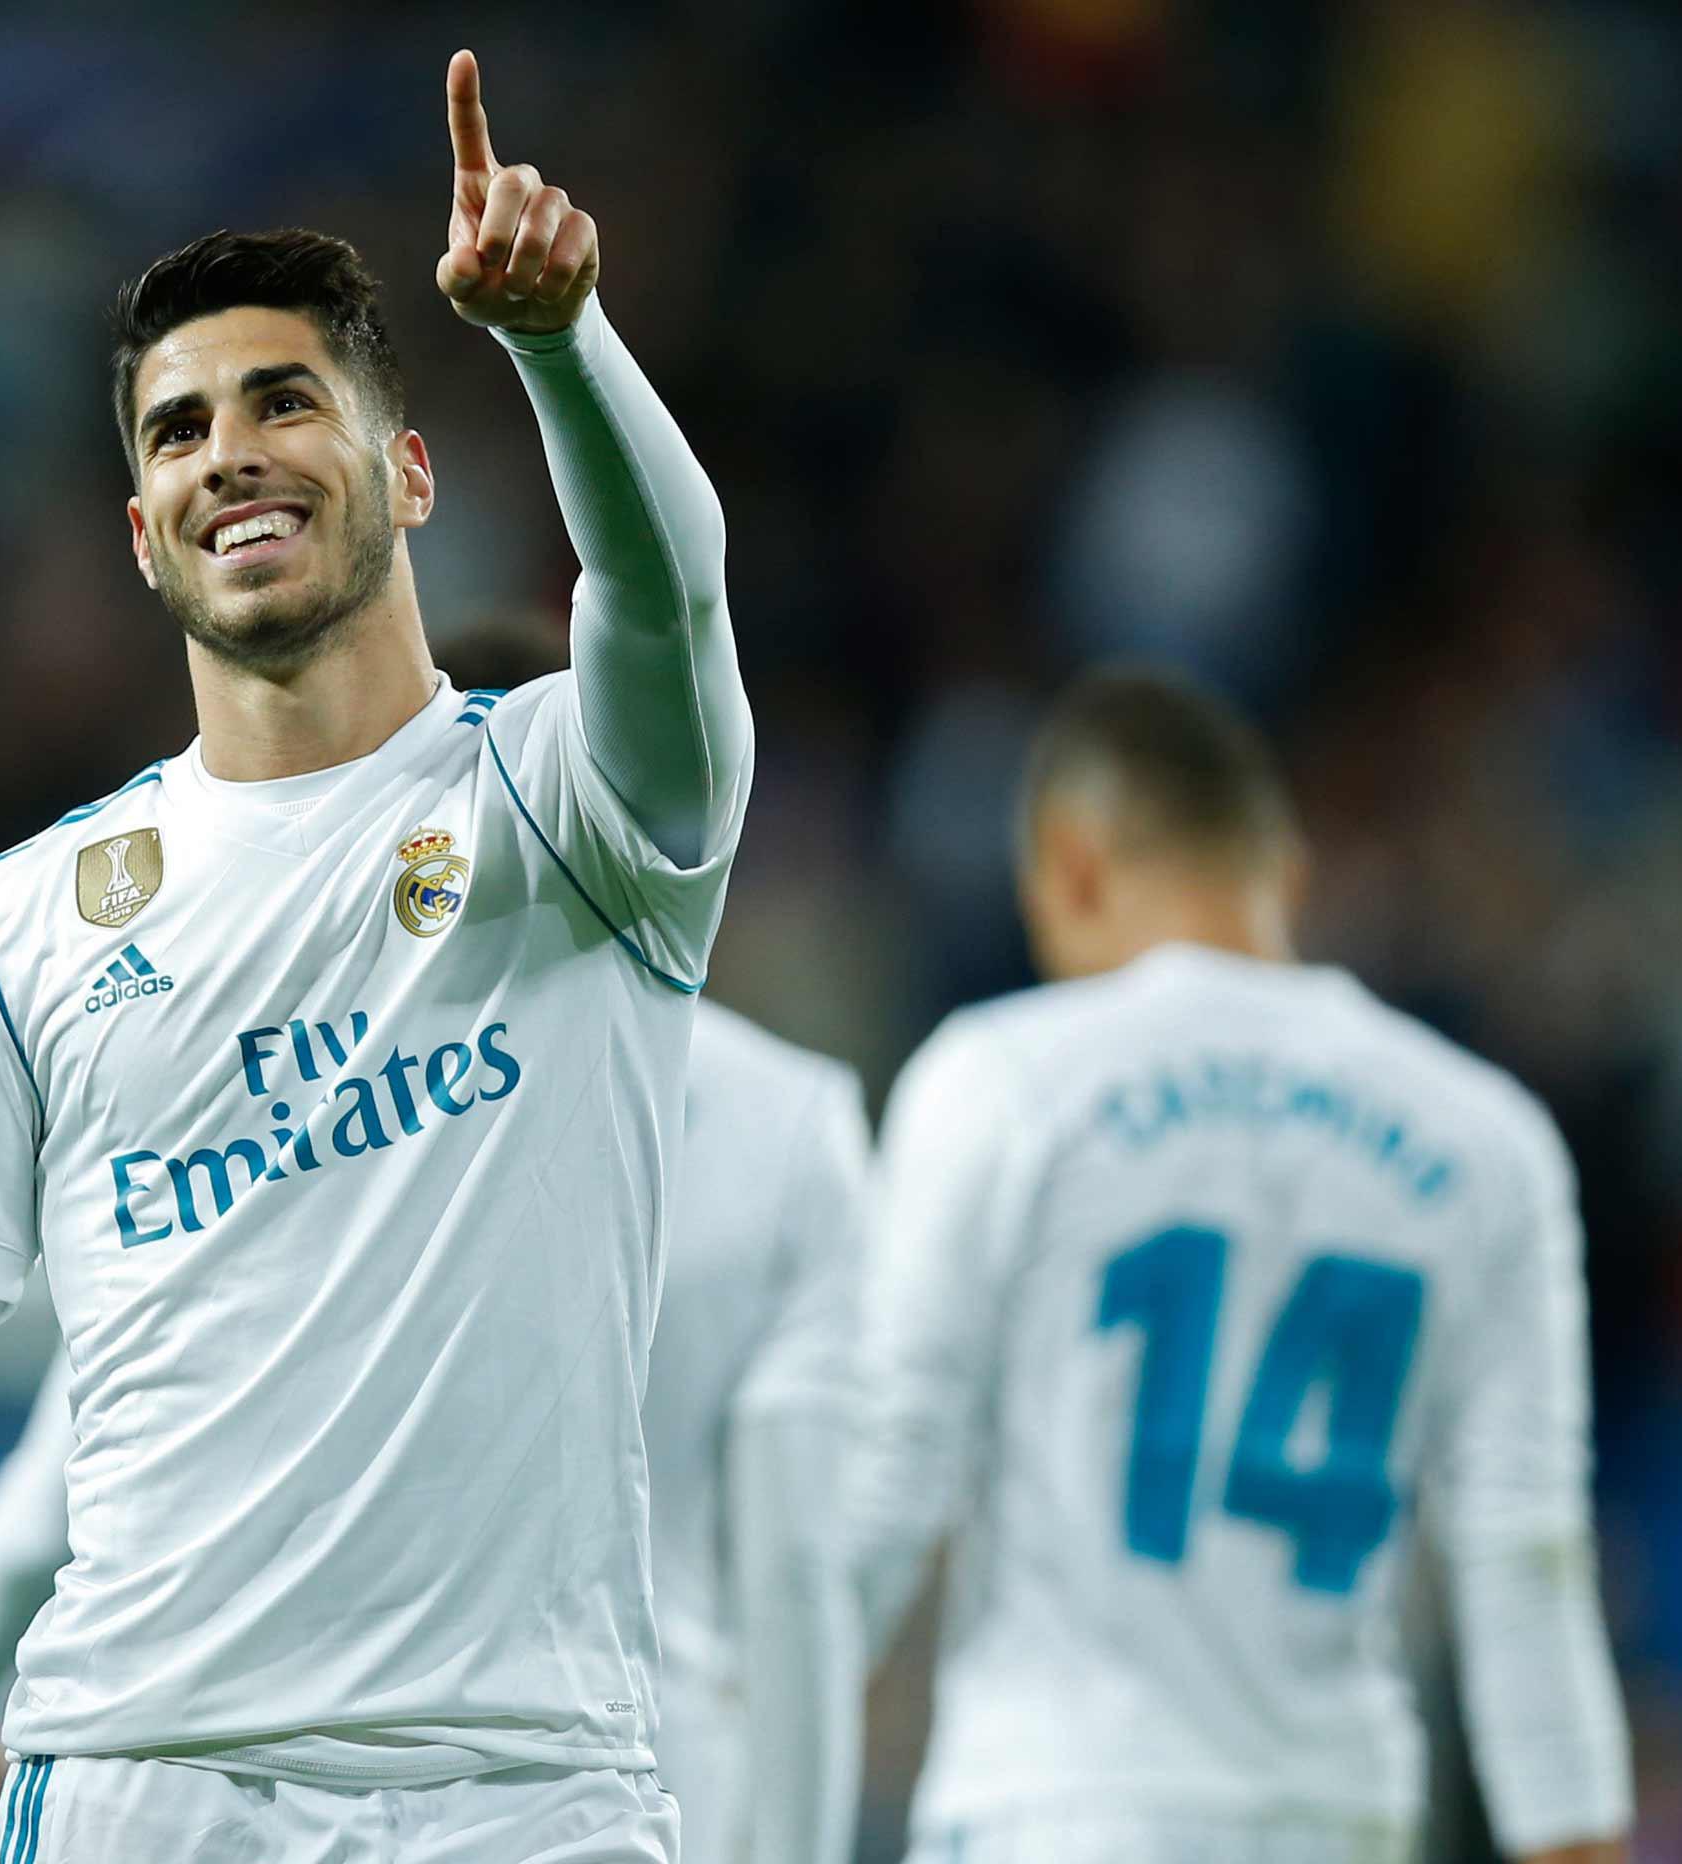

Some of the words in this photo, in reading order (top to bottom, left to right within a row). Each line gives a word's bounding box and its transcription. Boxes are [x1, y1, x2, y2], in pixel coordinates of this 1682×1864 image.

[100, 886, 141, 911] FIFA
[85, 974, 174, 1014] adidas
[237, 1010, 369, 1097] Fly
[109, 1021, 522, 1249] Emirates
[1094, 1224, 1427, 1597] 14
